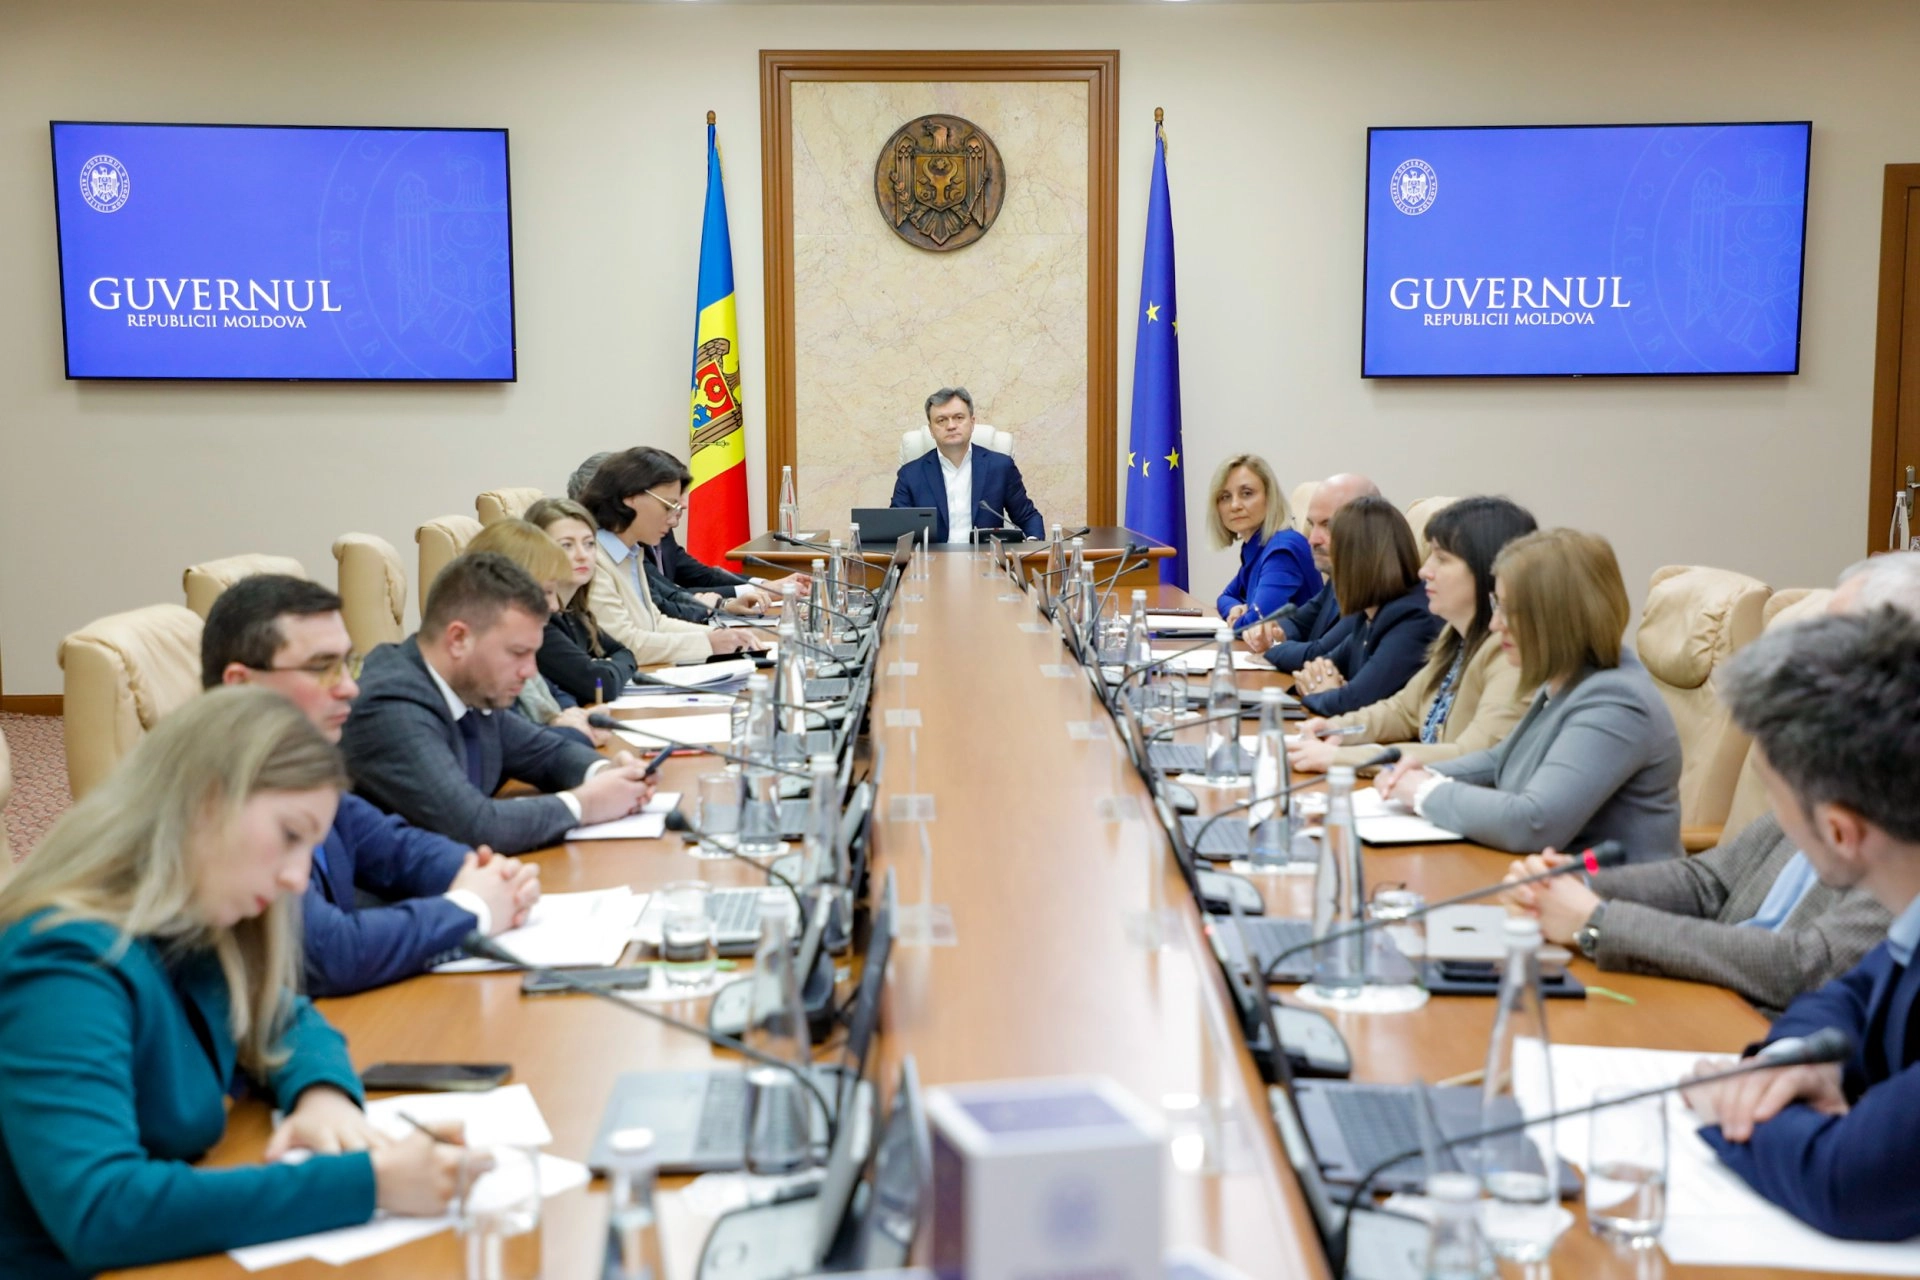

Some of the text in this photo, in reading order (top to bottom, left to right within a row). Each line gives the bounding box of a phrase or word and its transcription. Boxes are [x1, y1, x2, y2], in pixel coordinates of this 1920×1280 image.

[90, 278, 341, 311] GUVERNUL
[1390, 277, 1630, 309] GUVERNUL
[128, 315, 306, 328] REPUBLICII MOLDOVA
[1424, 313, 1594, 325] REPUBLICII MOLDOVA
